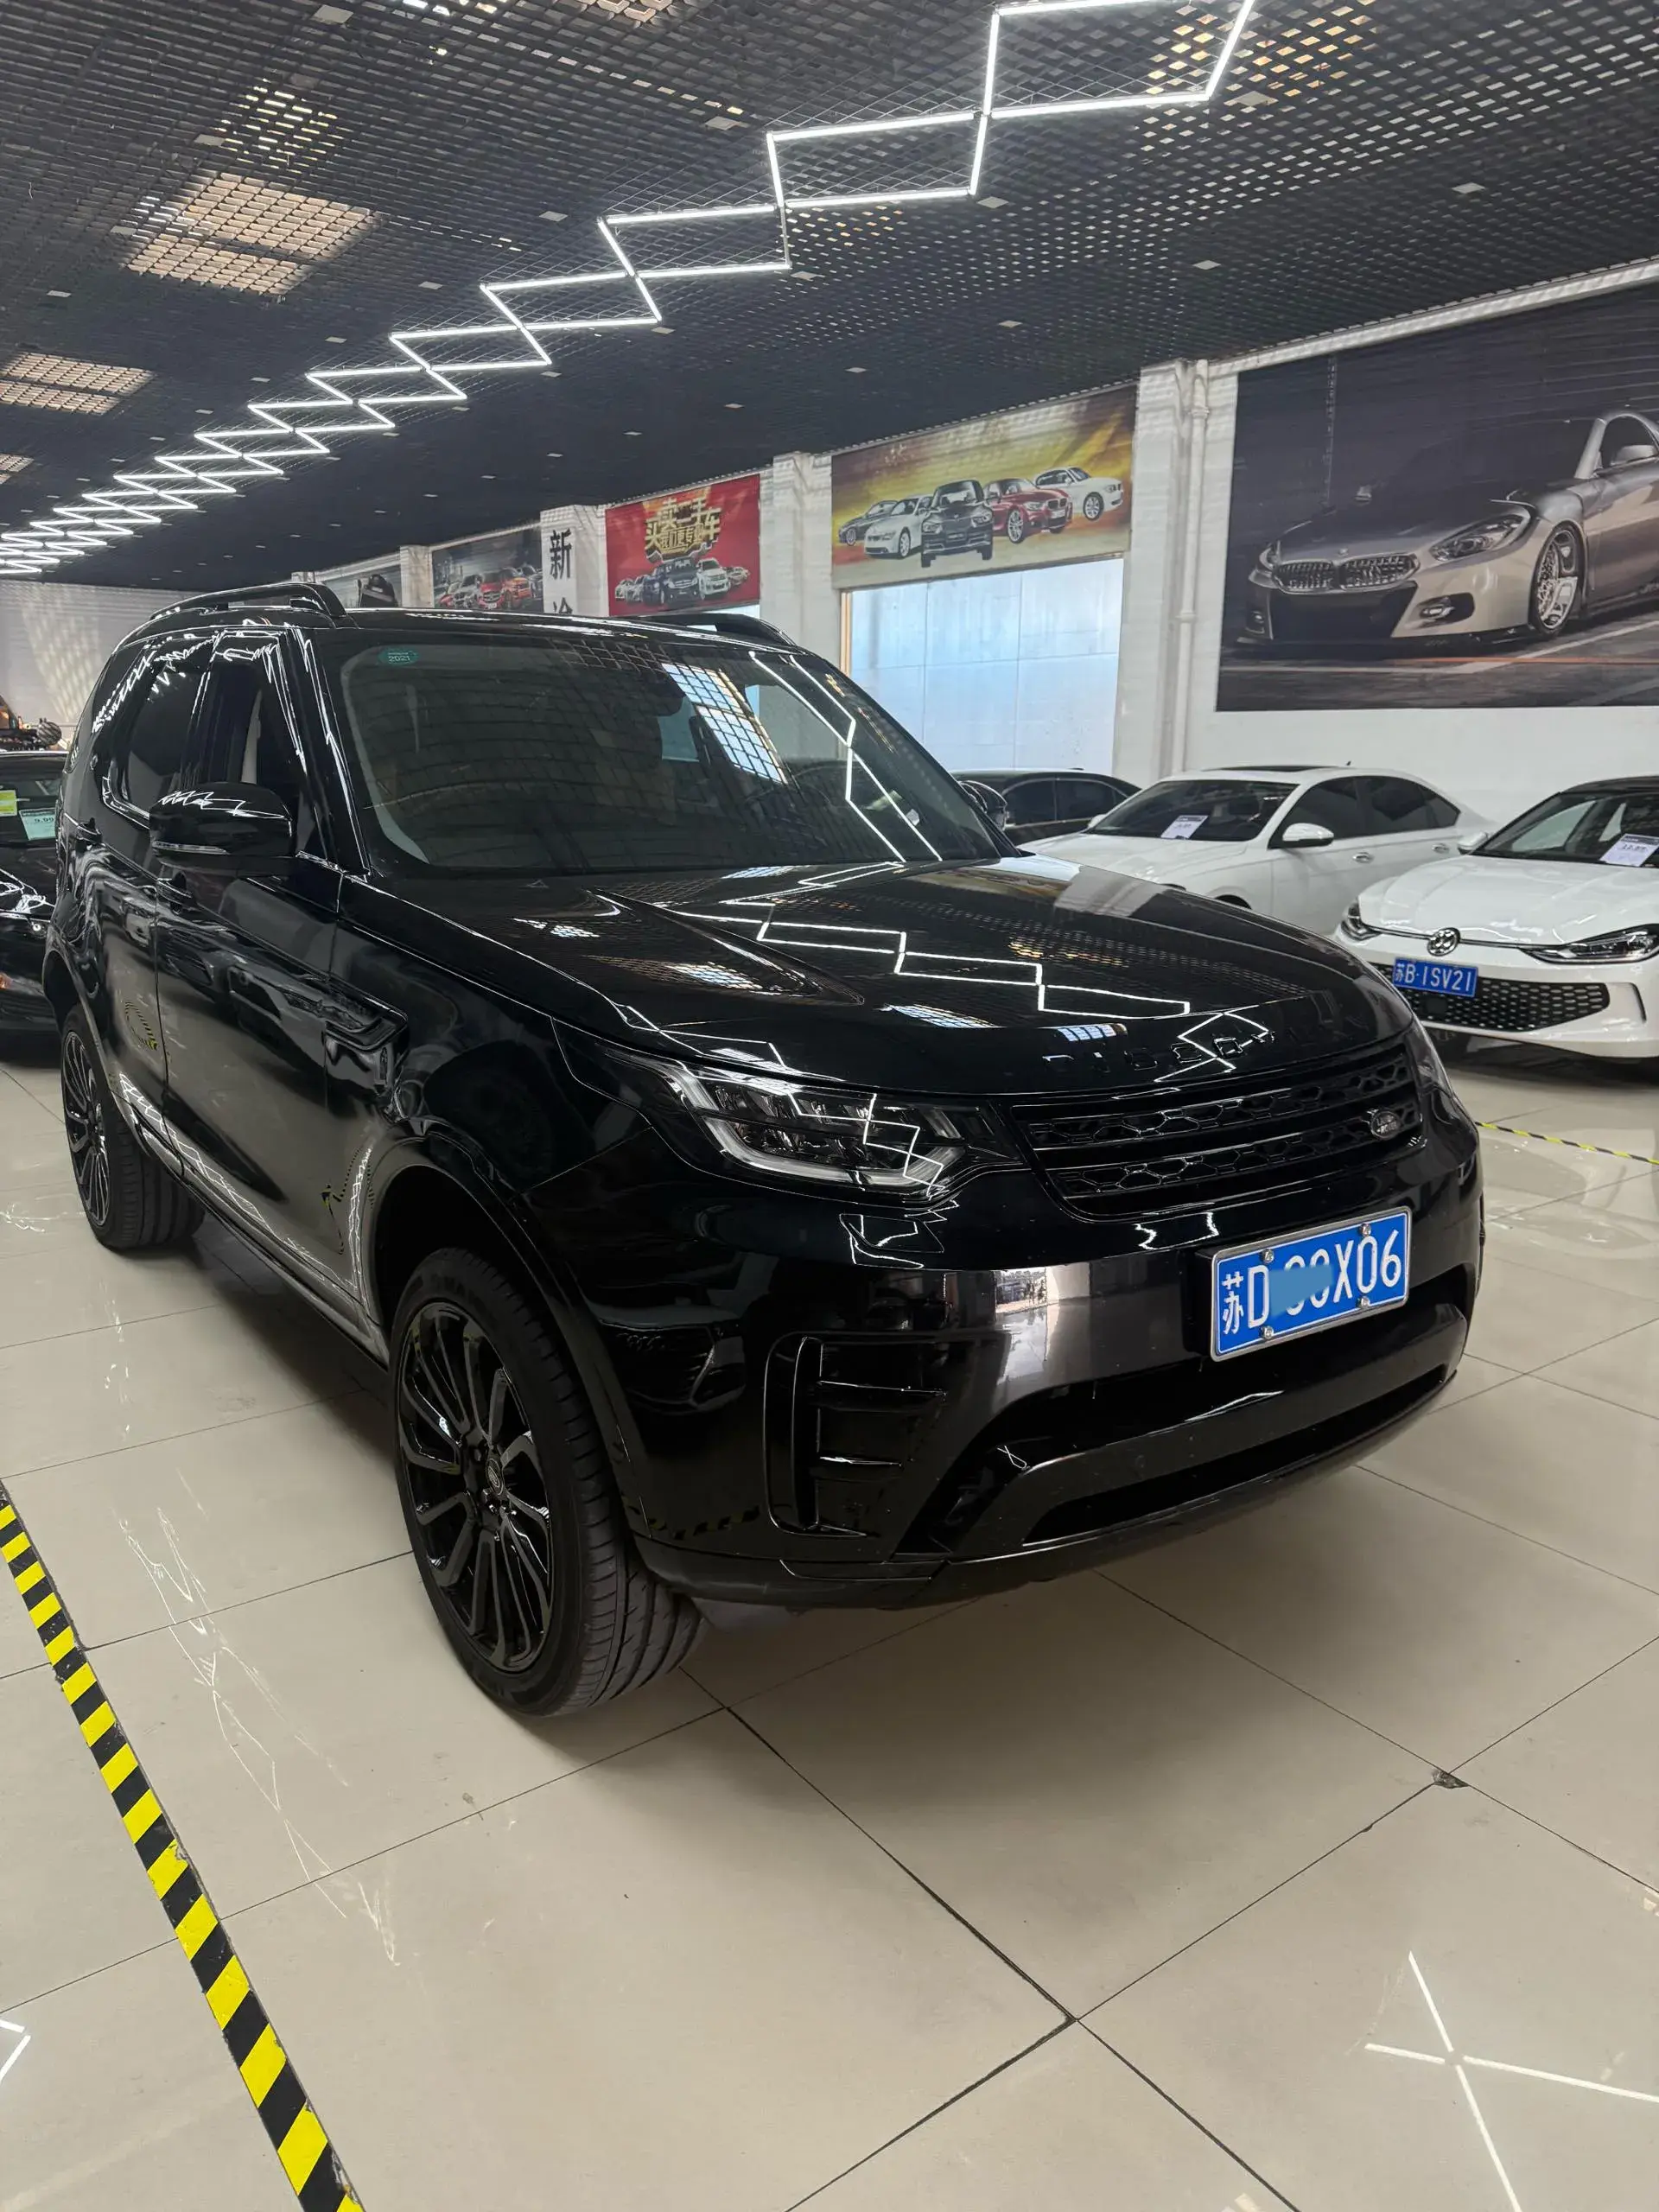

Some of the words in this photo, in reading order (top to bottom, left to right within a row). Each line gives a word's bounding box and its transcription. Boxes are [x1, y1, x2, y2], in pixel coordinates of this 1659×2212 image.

[645, 497, 721, 550] 买卖二手车
